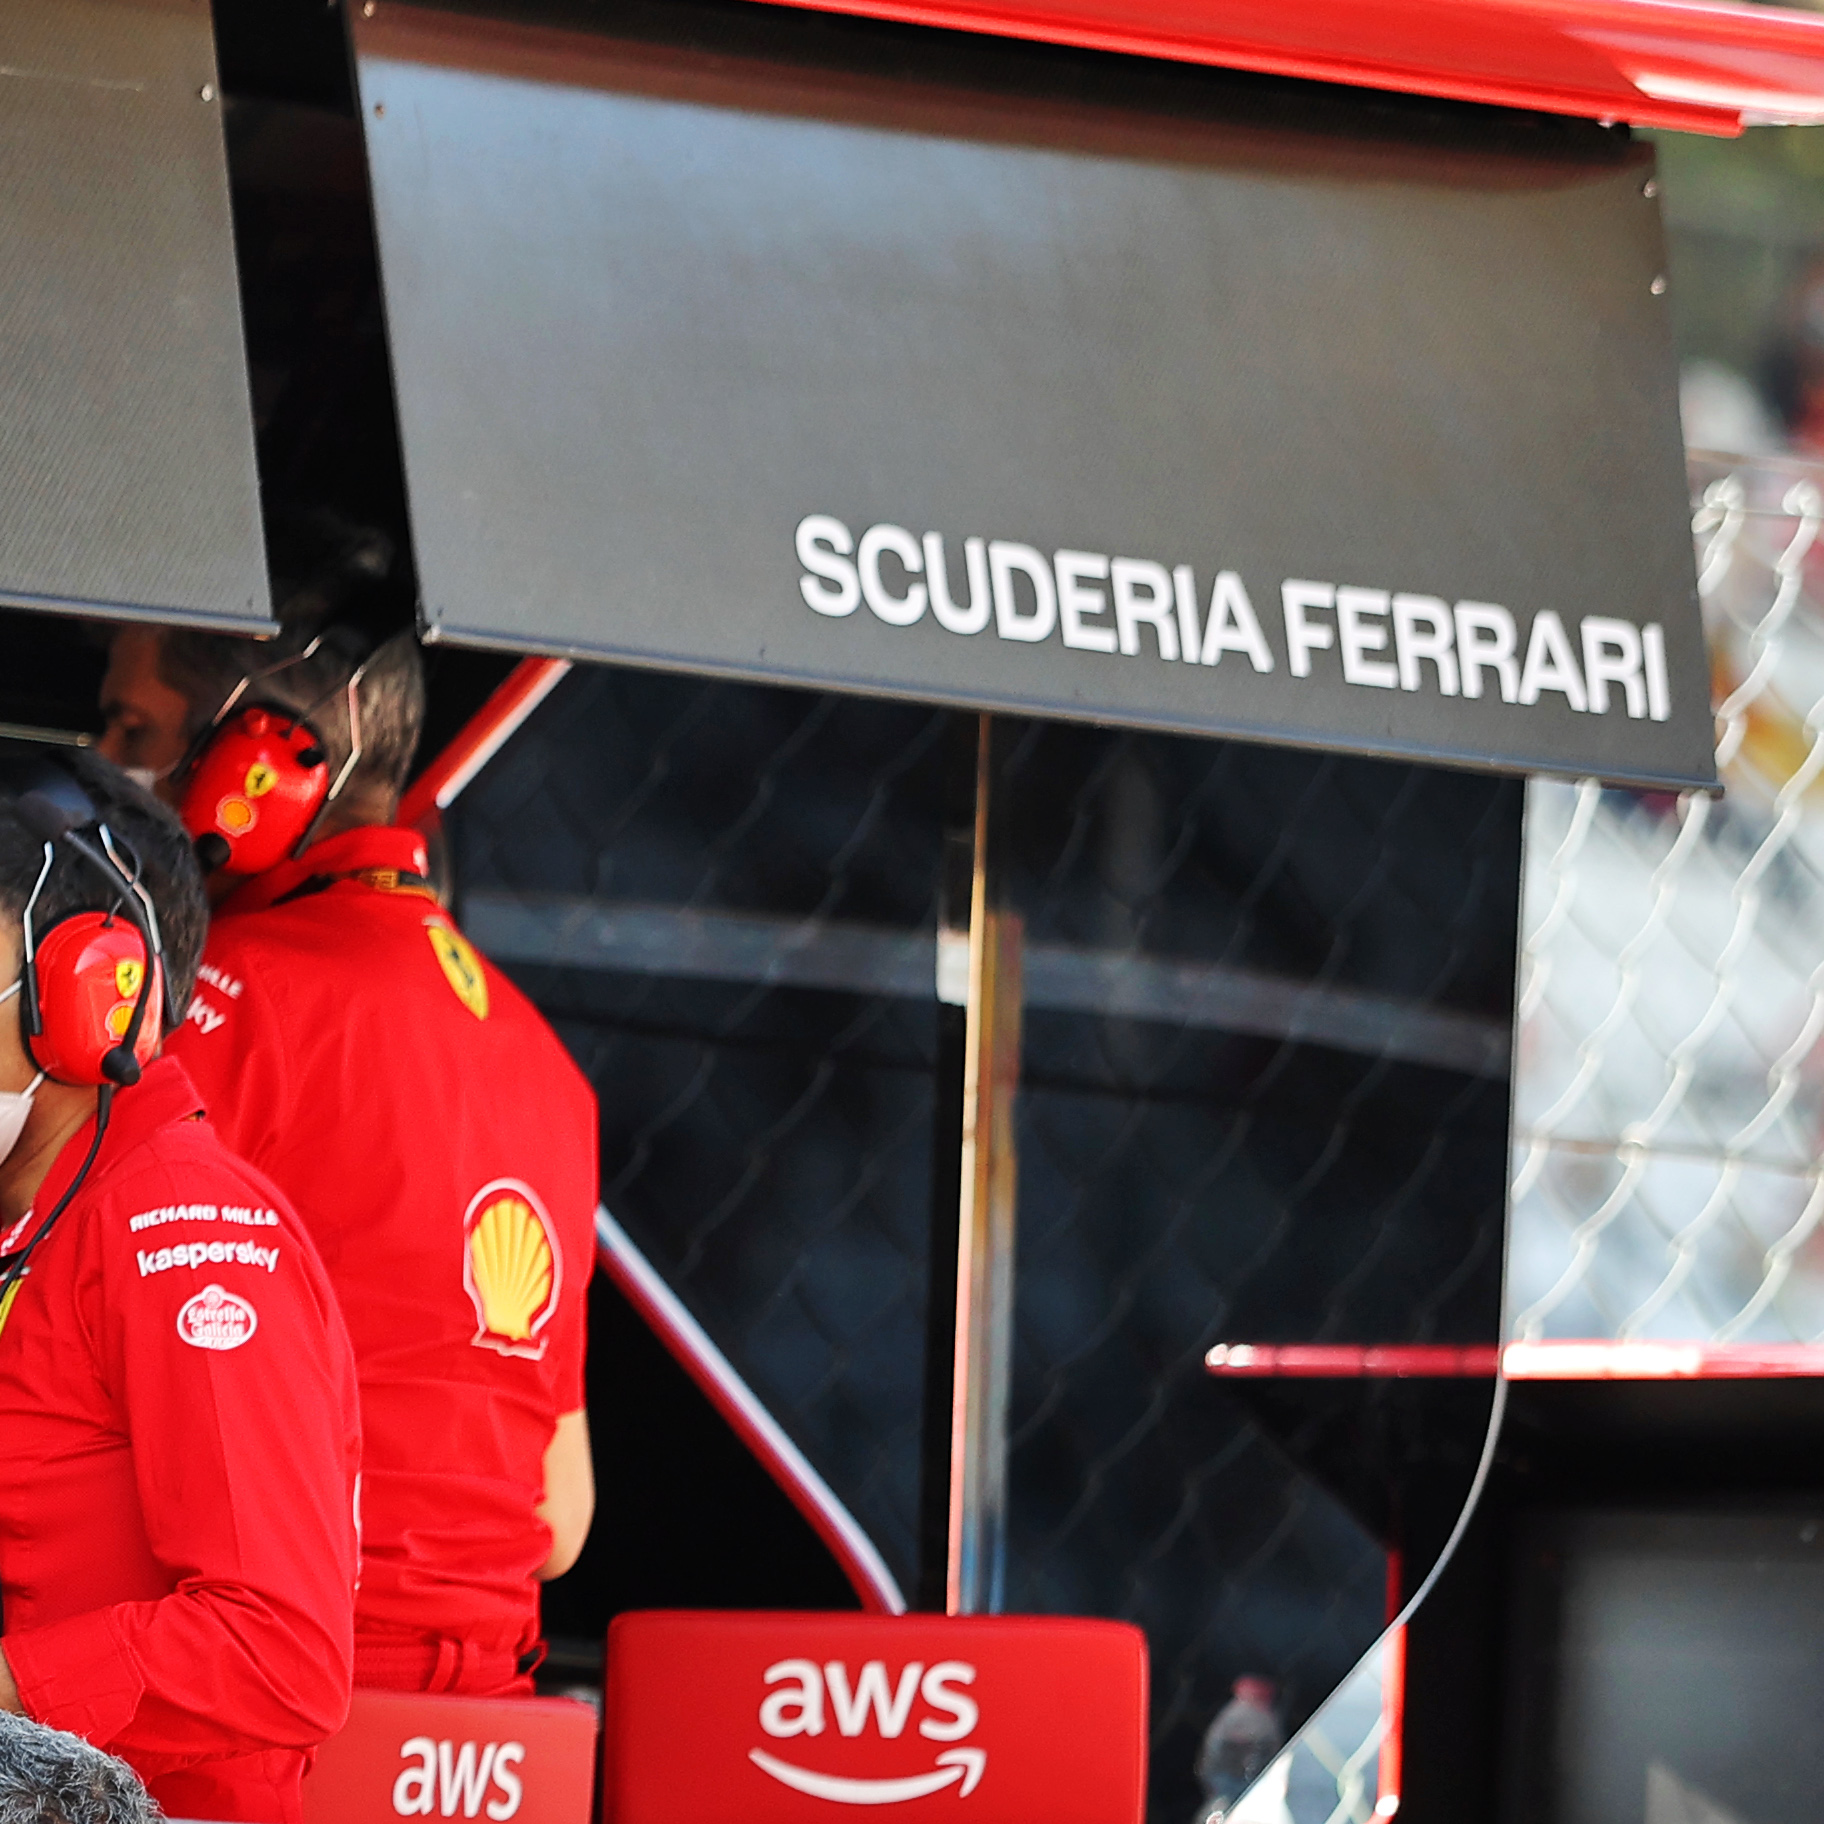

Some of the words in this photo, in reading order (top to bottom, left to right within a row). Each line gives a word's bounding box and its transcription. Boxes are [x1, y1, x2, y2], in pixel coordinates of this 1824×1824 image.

[795, 514, 1274, 674] SCUDERIA
[1281, 577, 1671, 721] FERRARI
[129, 1204, 219, 1233] RICHARD
[221, 1204, 281, 1227] MILLE
[136, 1239, 281, 1278] kaspersky
[758, 1659, 979, 1741] aws
[392, 1735, 525, 1821] aws
